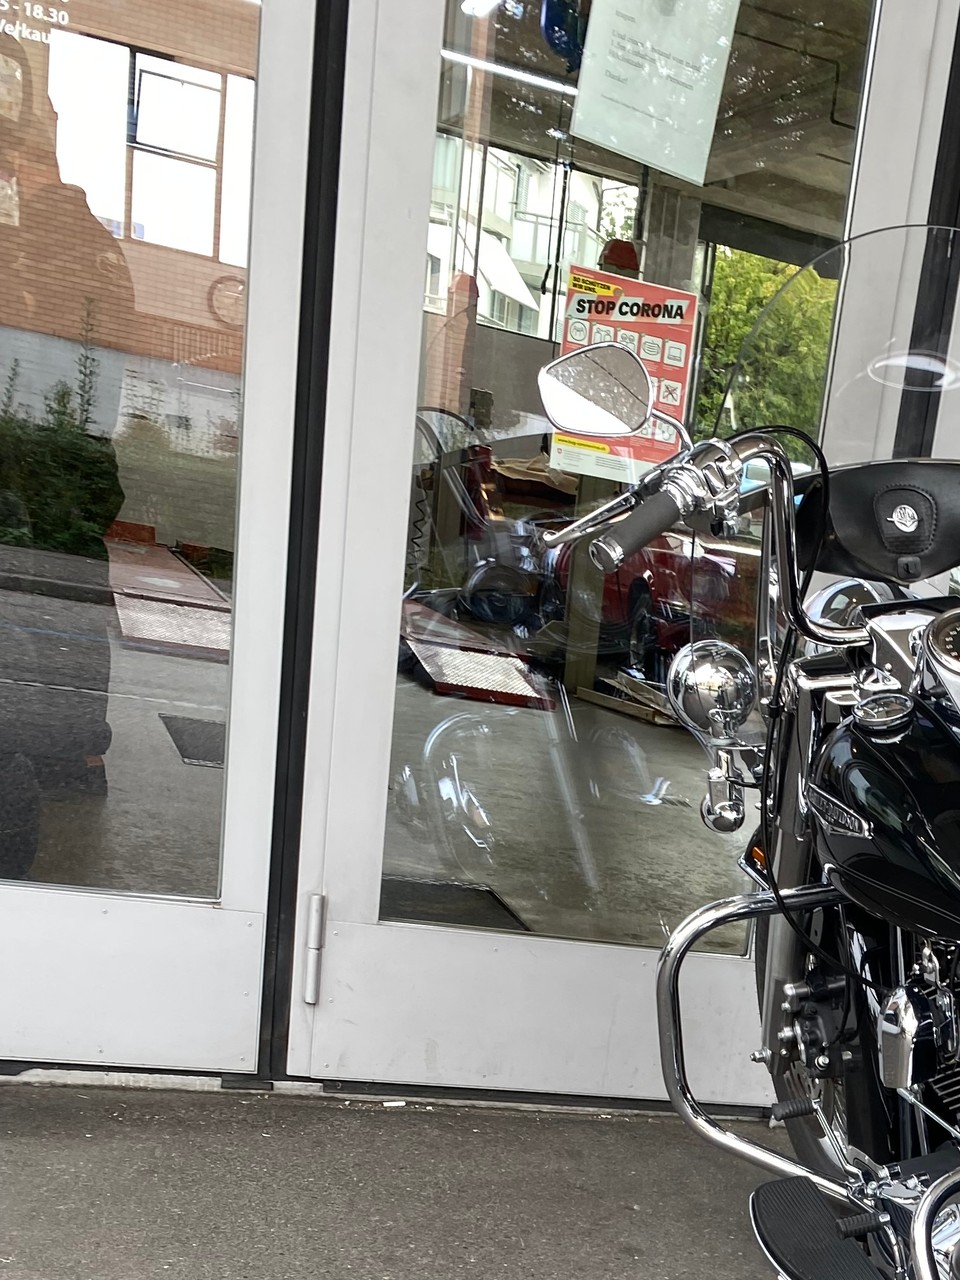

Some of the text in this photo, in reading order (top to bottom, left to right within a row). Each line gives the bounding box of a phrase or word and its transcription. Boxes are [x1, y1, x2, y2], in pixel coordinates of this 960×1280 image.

[24, 2, 69, 25] 18.30
[576, 299, 684, 319] STOP CORONA
